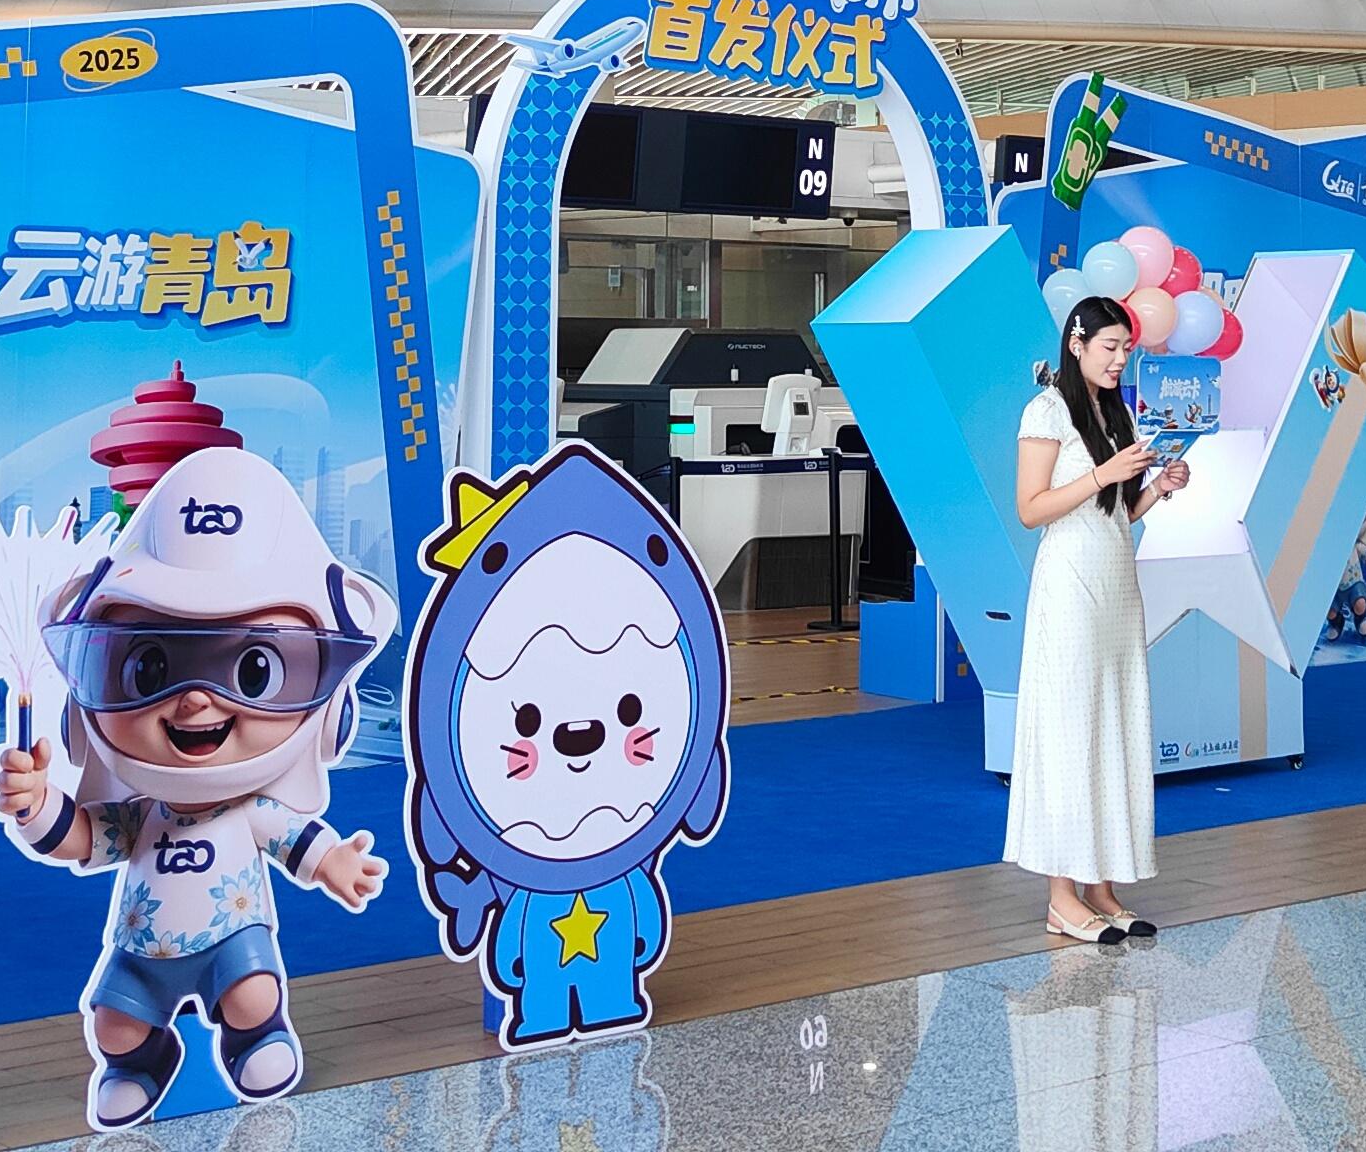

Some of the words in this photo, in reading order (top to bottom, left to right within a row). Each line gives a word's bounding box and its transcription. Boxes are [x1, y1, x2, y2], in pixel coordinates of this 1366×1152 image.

[77, 47, 142, 76] 2025
[808, 138, 823, 160] N
[1014, 152, 1029, 174] N
[799, 170, 827, 197] 09
[181, 501, 243, 537] tao
[154, 839, 216, 875] tao
